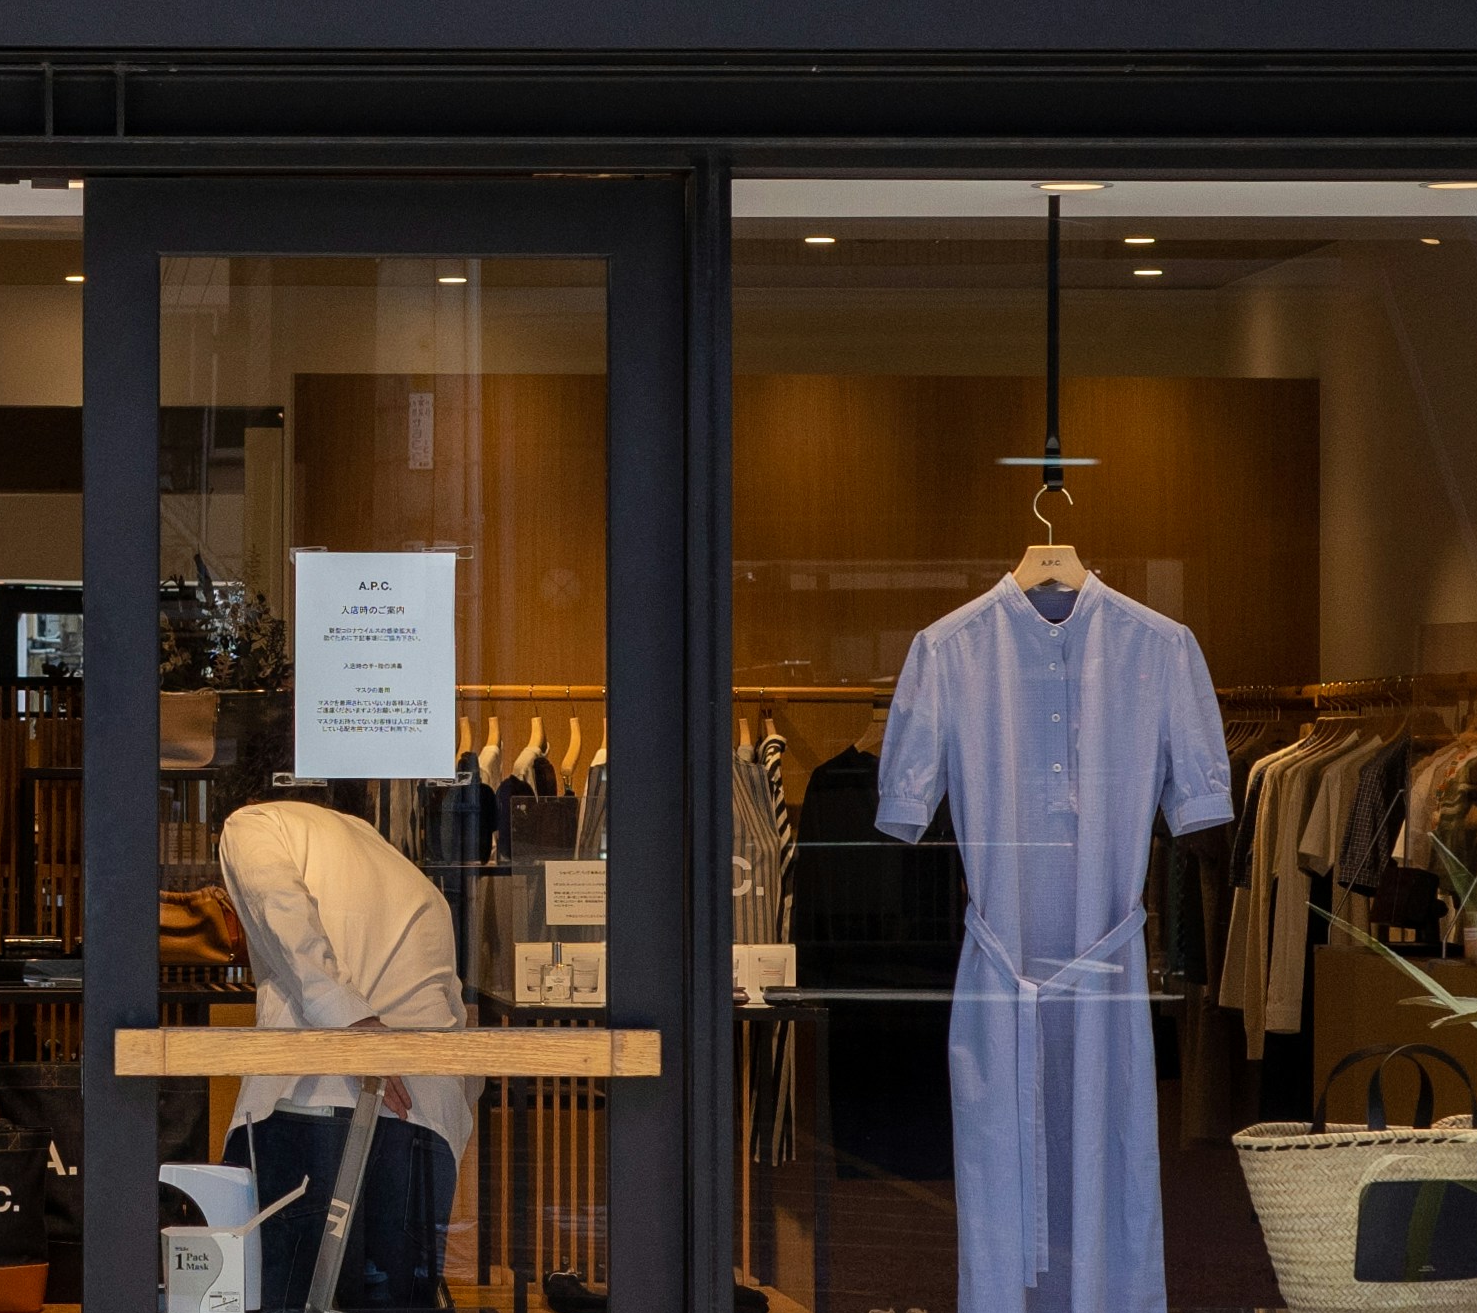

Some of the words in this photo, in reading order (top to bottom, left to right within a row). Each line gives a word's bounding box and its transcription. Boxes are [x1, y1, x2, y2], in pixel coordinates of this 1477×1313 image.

[358, 581, 392, 591] A.P.C.
[341, 605, 405, 615] 入店時のご案内
[174, 1253, 185, 1271] 1
[186, 1253, 210, 1262] Pack
[186, 1263, 209, 1271] Mask
